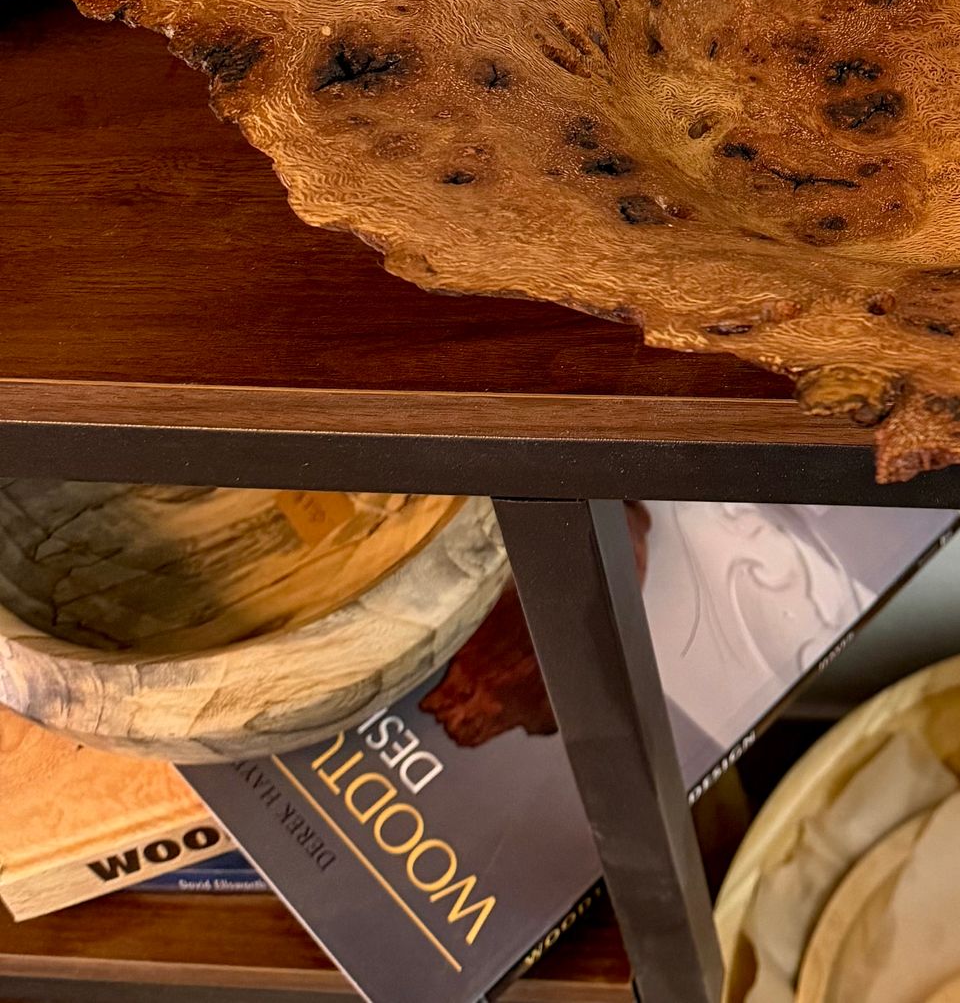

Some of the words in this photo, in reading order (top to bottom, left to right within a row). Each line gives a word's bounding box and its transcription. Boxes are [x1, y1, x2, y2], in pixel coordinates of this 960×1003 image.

[356, 707, 445, 795] DESI
[87, 826, 232, 883] WOO
[280, 801, 337, 872] DEREK
